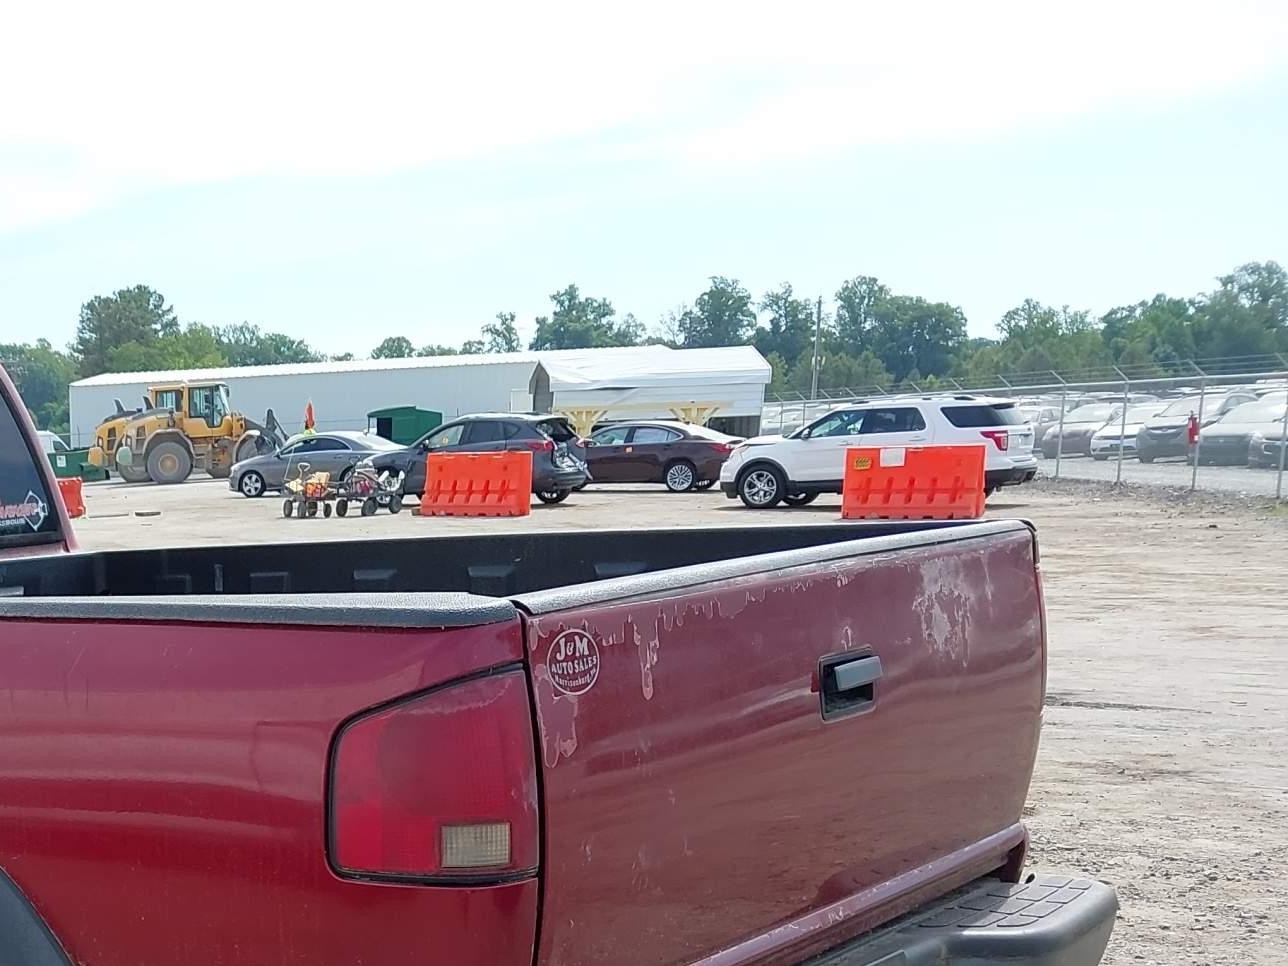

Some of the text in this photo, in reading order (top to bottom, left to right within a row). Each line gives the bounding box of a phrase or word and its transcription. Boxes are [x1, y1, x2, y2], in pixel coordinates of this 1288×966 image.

[556, 635, 589, 660] J&M
[551, 655, 597, 675] AUTO SALES
